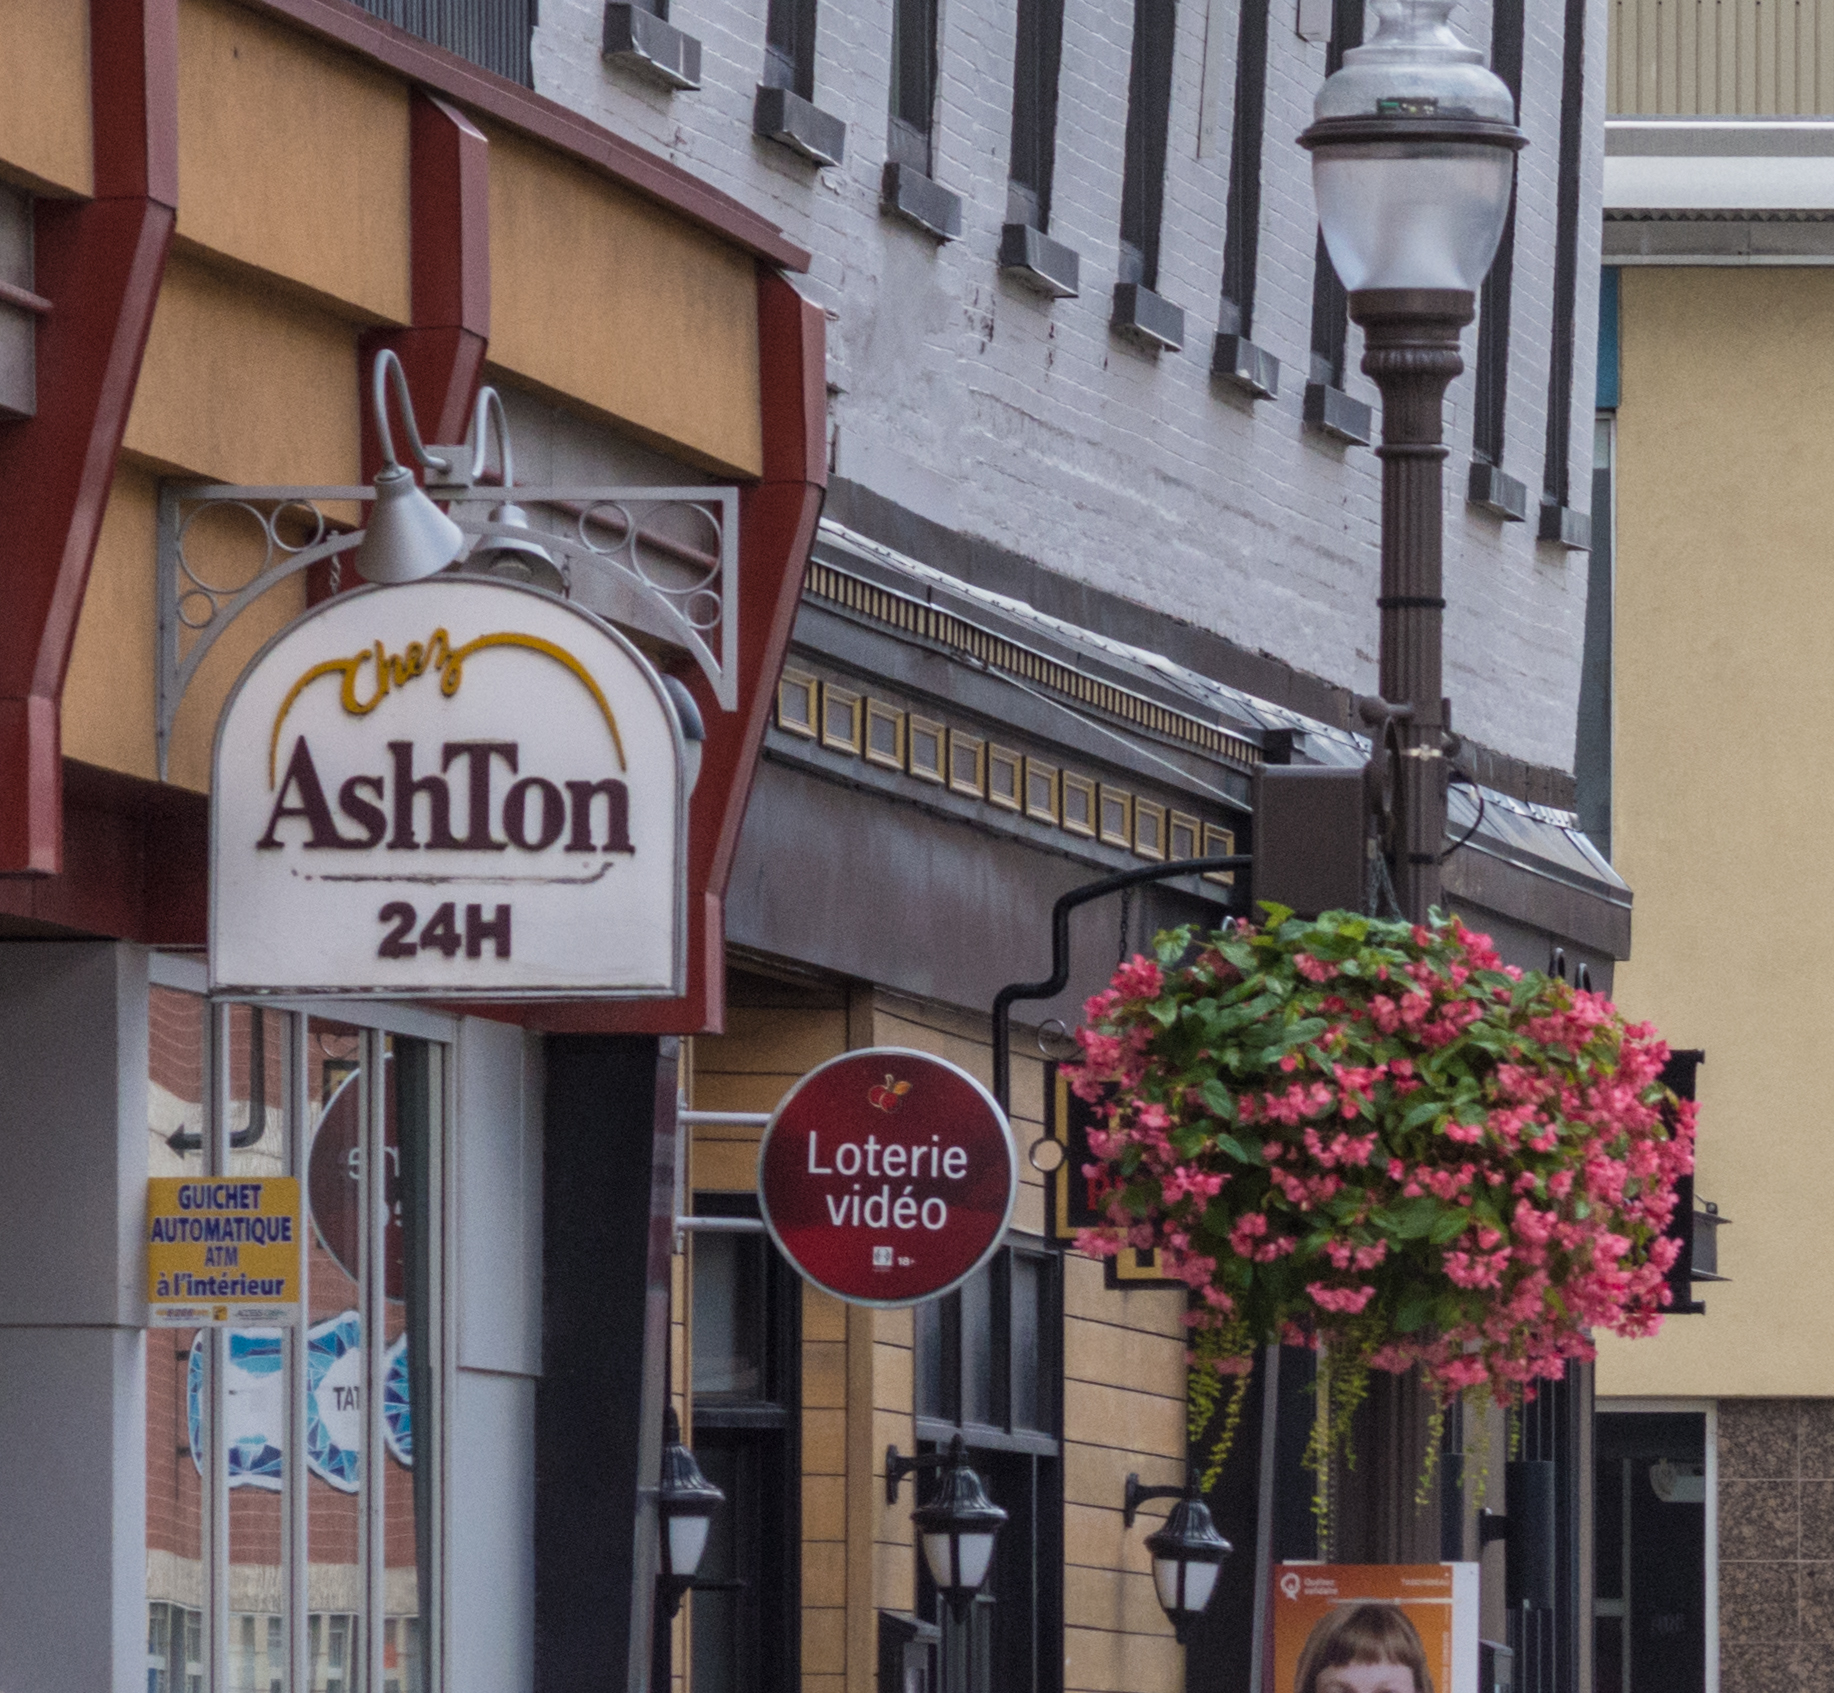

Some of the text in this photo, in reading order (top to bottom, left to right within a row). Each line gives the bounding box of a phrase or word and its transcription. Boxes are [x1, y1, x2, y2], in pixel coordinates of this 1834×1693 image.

[340, 627, 464, 715] Chez
[255, 734, 636, 856] AshTon
[376, 900, 512, 958] 24H
[807, 1130, 969, 1180] Loterie
[177, 1183, 263, 1211] GUICHET
[825, 1183, 948, 1231] vidéo
[150, 1216, 293, 1246] AUTOMATIQUE
[204, 1246, 239, 1268] ATM
[156, 1271, 171, 1297] à
